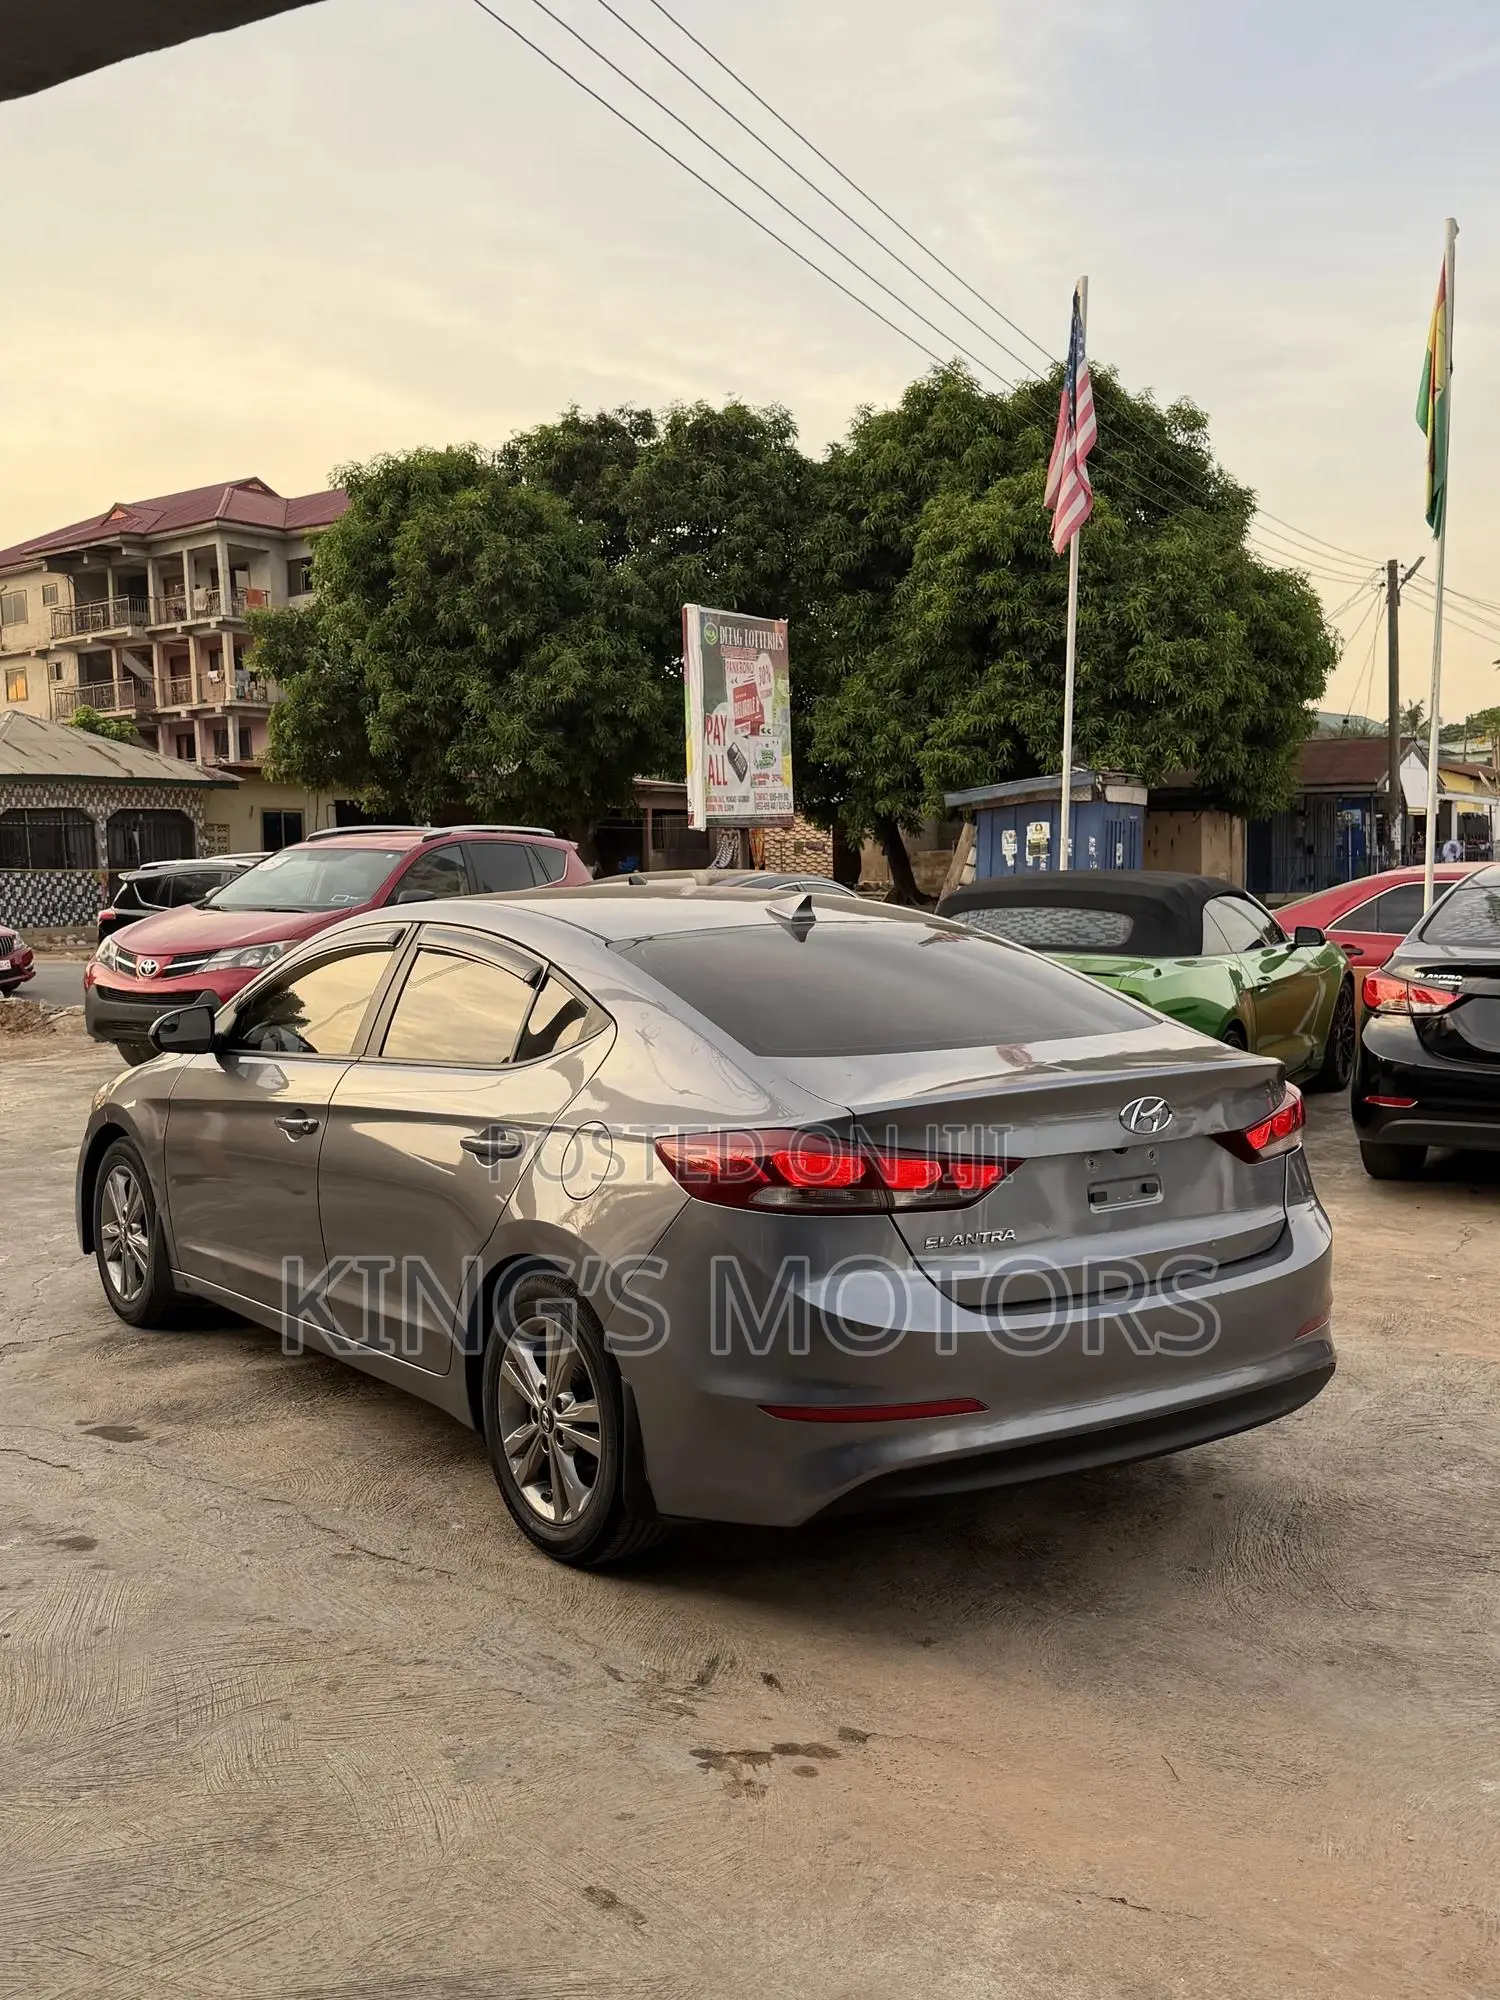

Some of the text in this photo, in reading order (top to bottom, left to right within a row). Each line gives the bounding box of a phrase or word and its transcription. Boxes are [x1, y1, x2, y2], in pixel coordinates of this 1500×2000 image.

[744, 629, 784, 650] LOTTERIES
[706, 712, 728, 747] PAY
[708, 754, 729, 786] ALL
[924, 1229, 1017, 1250] ELANTRA
